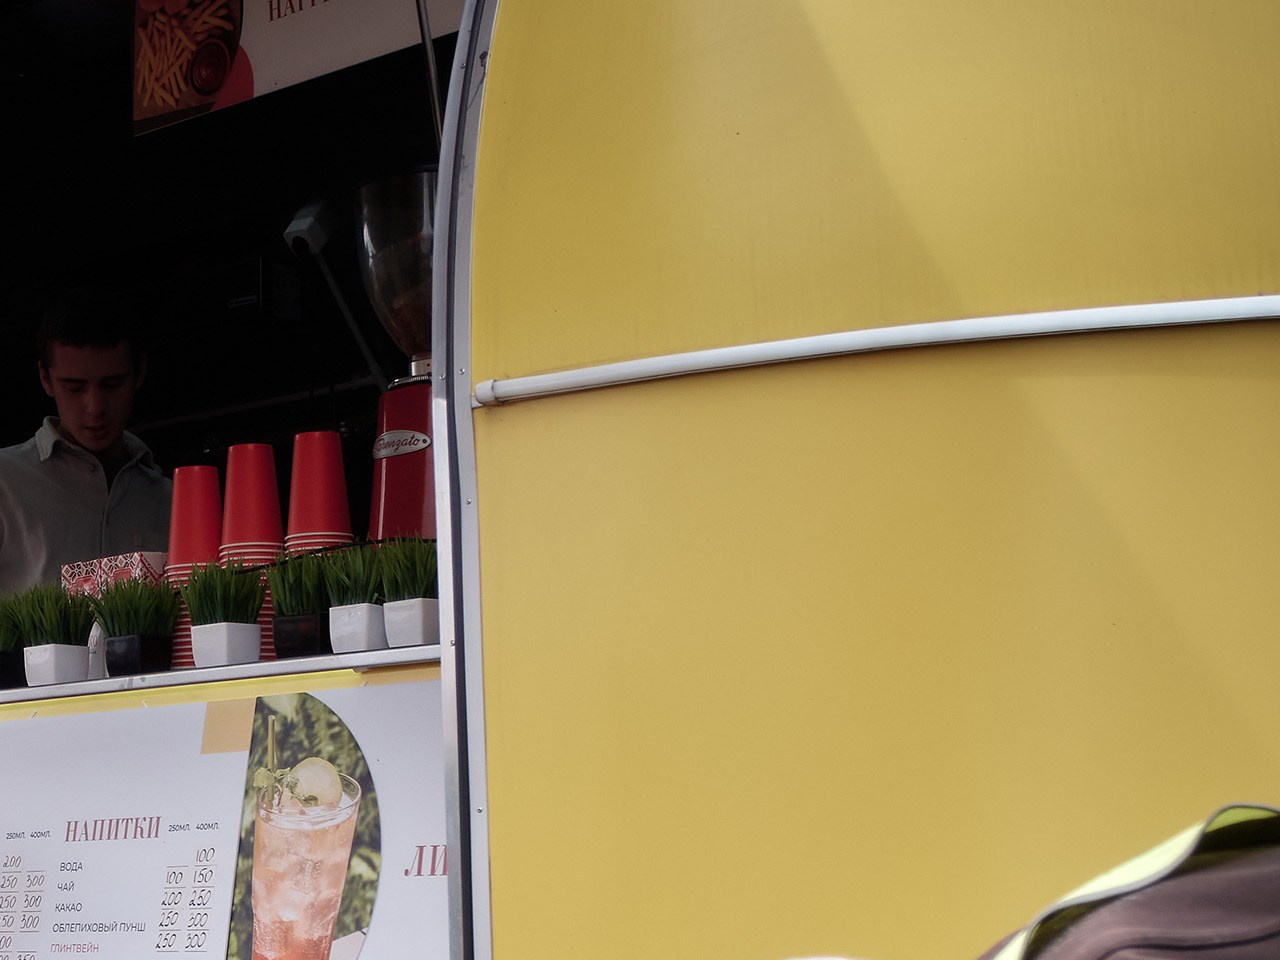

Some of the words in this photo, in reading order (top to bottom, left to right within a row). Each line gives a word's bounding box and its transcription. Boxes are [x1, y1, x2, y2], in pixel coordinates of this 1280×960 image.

[64, 816, 162, 842] НАПИТКИ
[2, 855, 22, 868] 200
[195, 847, 216, 863] 100
[60, 862, 83, 872] ВОДА
[0, 875, 18, 889] 250
[26, 874, 45, 888] 300
[166, 871, 184, 885] 100
[193, 867, 213, 883] 150
[57, 881, 75, 891] ЧАЙ
[23, 894, 42, 909] 300
[161, 891, 182, 906] 200
[189, 889, 212, 906] 250
[55, 902, 83, 912] КАКАО
[20, 914, 40, 929] 300
[158, 910, 179, 927] 250
[187, 912, 208, 928] 300
[52, 922, 117, 933] ОБЛЕПИХОВЫЙ
[120, 922, 146, 932] ПУНШ
[50, 943, 99, 953] ГЛИНТВЕЙН
[155, 932, 177, 949] 250
[184, 932, 207, 949] 300
